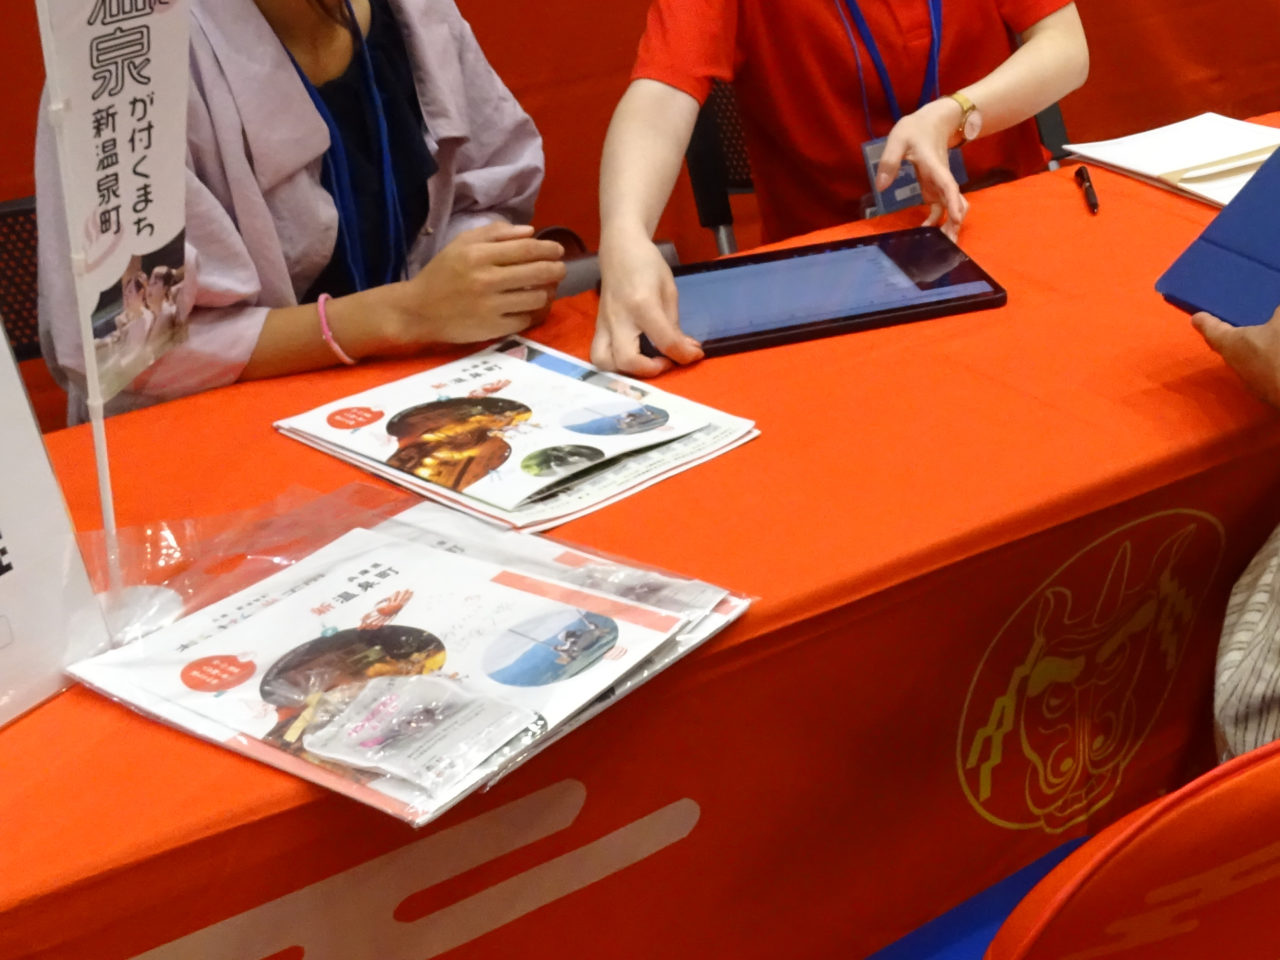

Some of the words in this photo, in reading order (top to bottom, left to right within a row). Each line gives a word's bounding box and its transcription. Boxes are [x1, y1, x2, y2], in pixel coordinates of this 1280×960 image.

[92, 103, 122, 235] 新温泉町
[128, 90, 155, 237] が付くまち
[310, 566, 400, 617] 新温泉町
